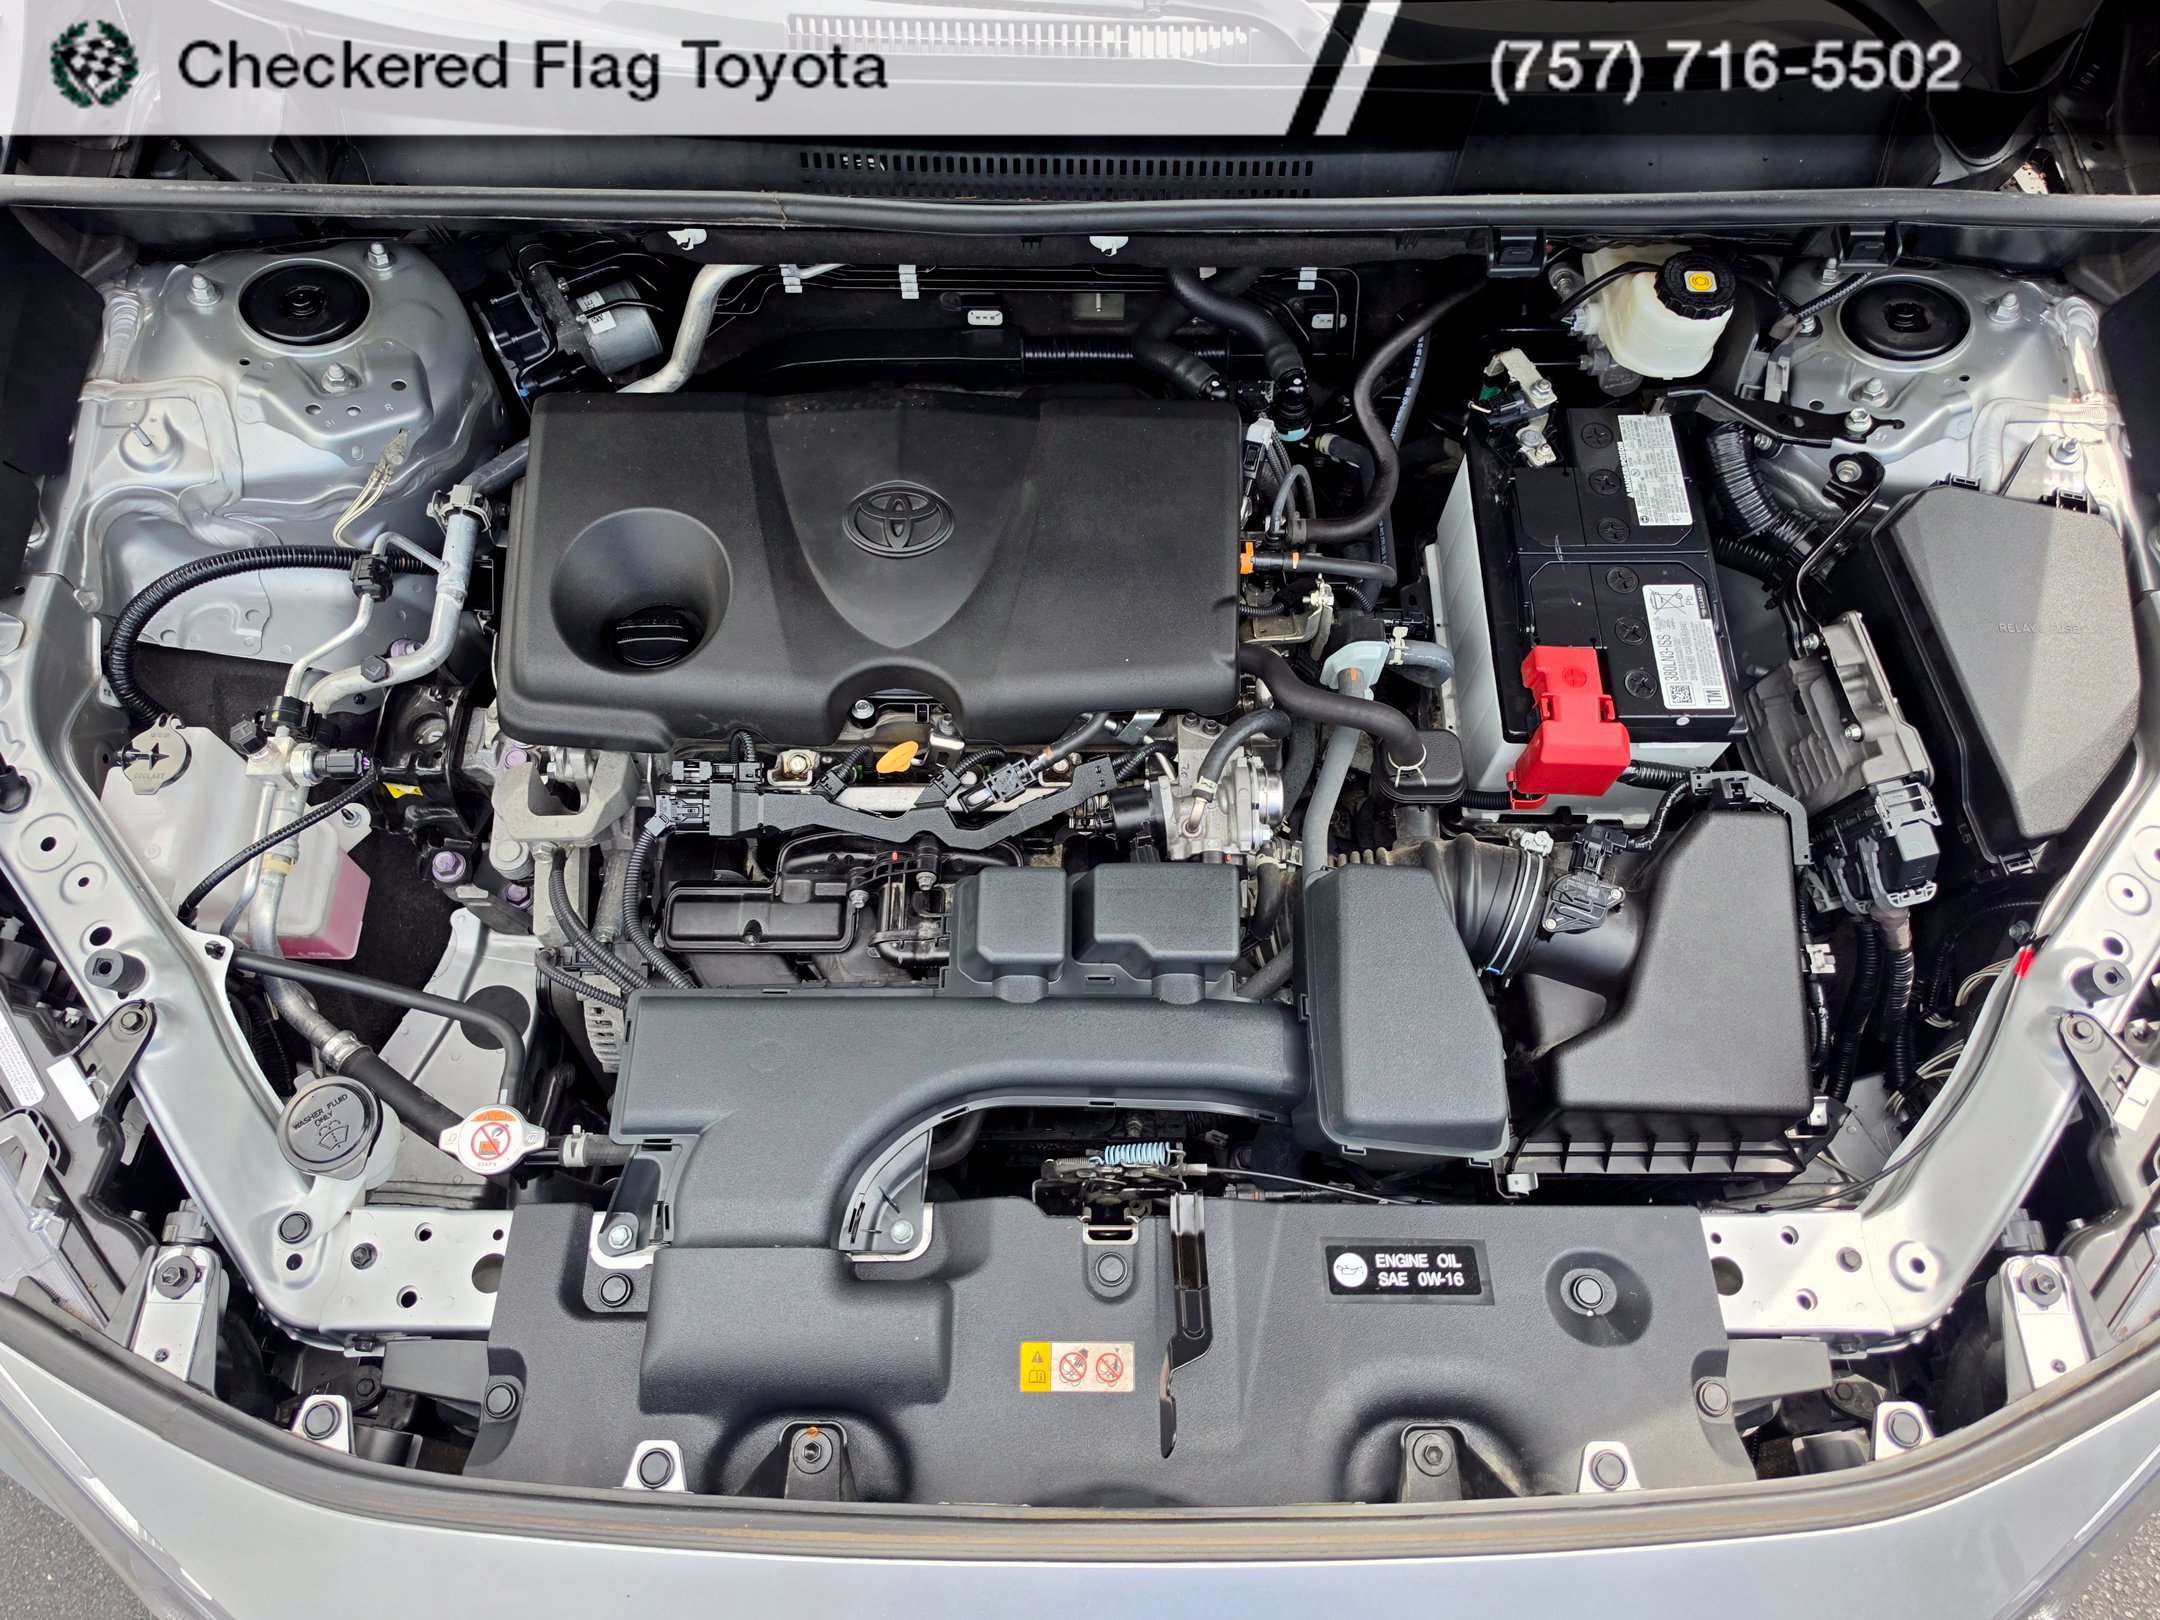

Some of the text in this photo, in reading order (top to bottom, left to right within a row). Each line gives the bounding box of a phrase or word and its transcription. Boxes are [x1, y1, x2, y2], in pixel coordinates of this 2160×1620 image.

[1685, 595, 1695, 606] Pb
[1998, 623, 2036, 634] RELAY
[1656, 634, 1680, 682] 380LN3-ISS
[1705, 690, 1723, 704] TM
[292, 1093, 348, 1131] WASHER FLUID
[314, 1111, 333, 1127] ONLY
[1374, 1253, 1462, 1268] ENGINE OIL
[1377, 1271, 1465, 1287] SAE 0W-16
